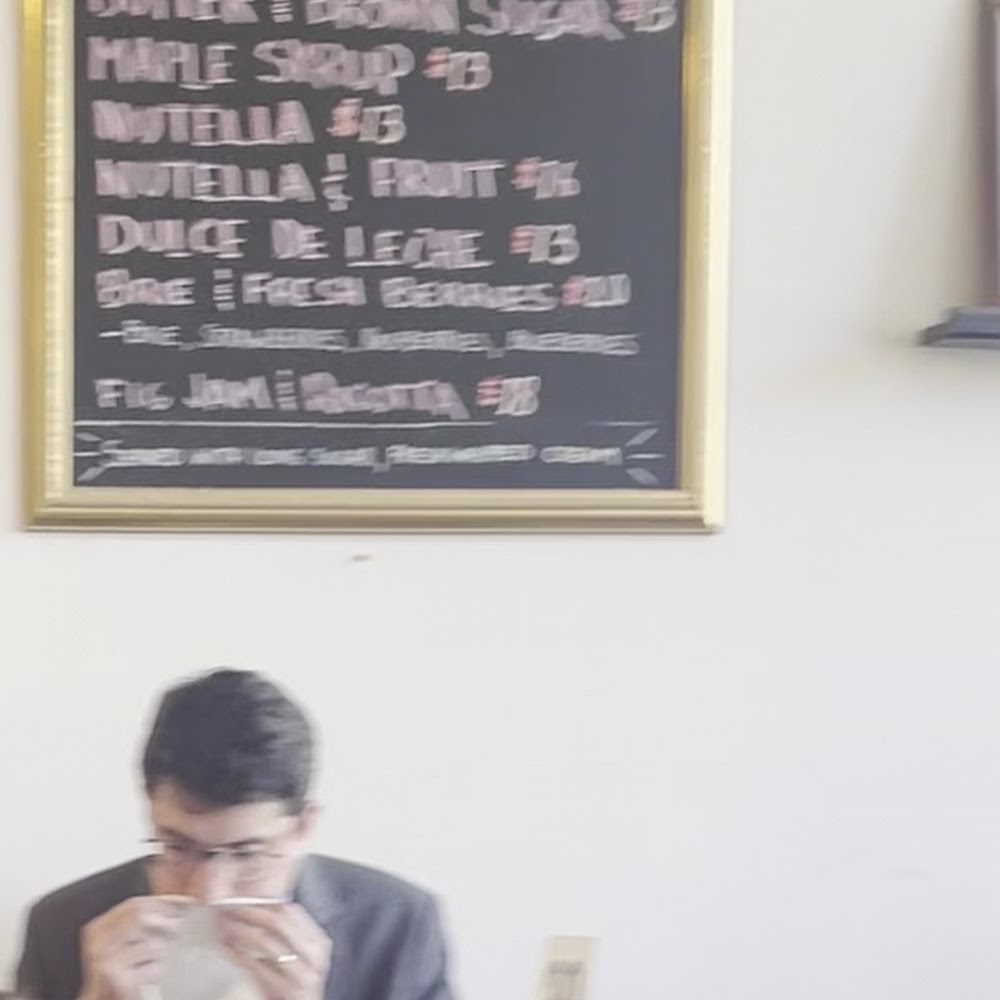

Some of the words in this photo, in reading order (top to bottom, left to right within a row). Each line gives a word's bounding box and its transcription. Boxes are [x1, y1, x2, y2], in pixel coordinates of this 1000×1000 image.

[87, 37, 237, 90] MAPLE
[253, 39, 415, 95] SYRUP
[92, 100, 314, 146] NUTELLA
[96, 159, 315, 202] NUTELLA
[369, 158, 506, 198] FRUIT
[97, 215, 249, 258] DULCE
[270, 218, 329, 259] DE
[344, 226, 495, 268] LECHE
[96, 269, 196, 308] BRIE
[242, 272, 367, 306] FRESH
[380, 277, 558, 311] BERRIES
[94, 379, 175, 410] FIG
[181, 373, 274, 410] JAM
[300, 372, 471, 419] RICOTTA
